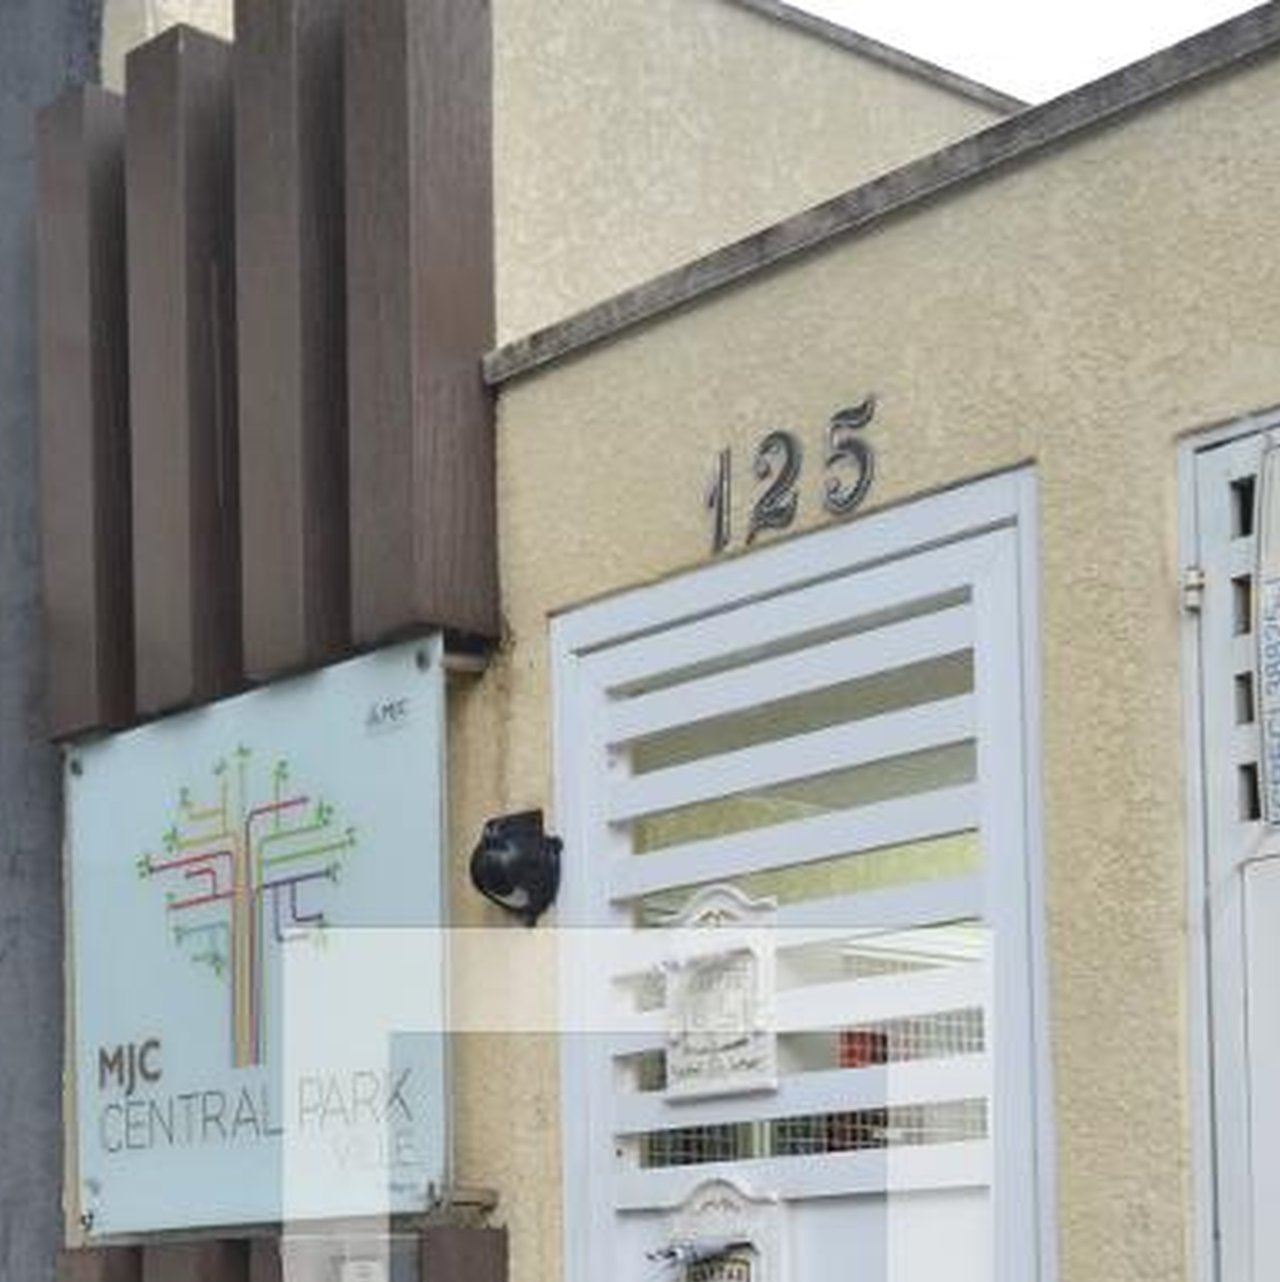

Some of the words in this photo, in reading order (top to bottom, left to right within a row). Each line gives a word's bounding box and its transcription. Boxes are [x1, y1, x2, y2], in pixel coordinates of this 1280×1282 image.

[708, 395, 876, 552] 125
[98, 1040, 163, 1097] MJC
[101, 1085, 284, 1152] CENTRAL
[299, 1067, 415, 1128] PARK
